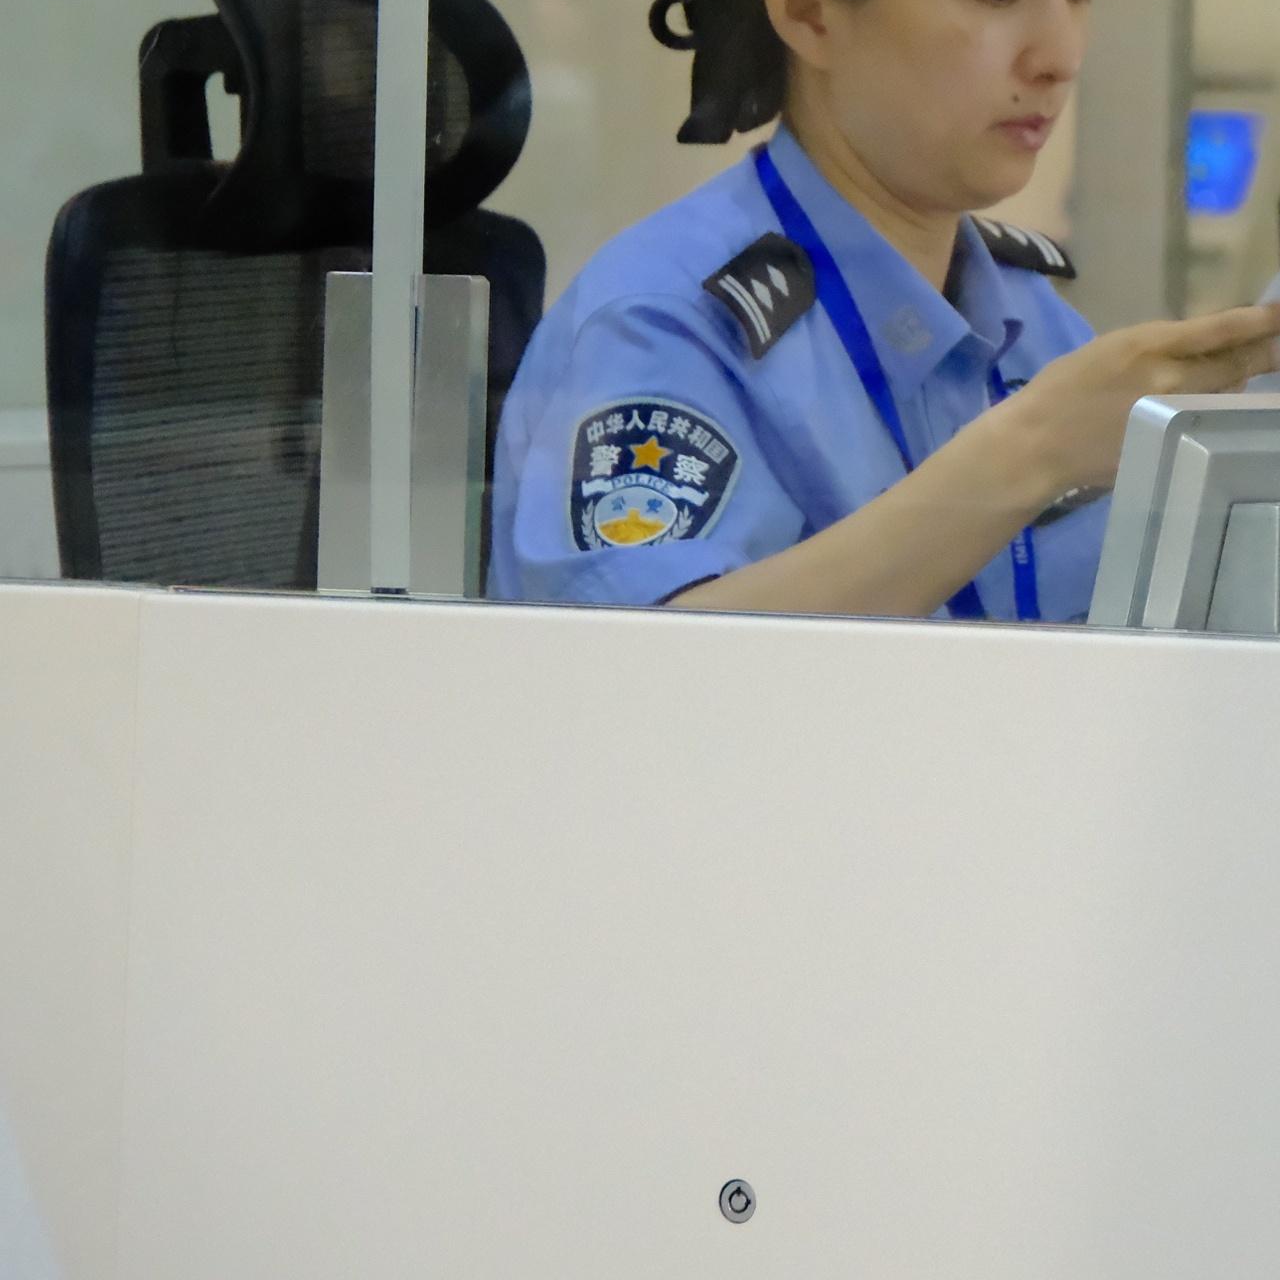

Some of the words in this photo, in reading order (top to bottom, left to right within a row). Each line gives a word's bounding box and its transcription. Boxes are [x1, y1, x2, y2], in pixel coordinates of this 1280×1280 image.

[586, 409, 730, 465] 中华人民共和国
[612, 474, 671, 493] POLICE
